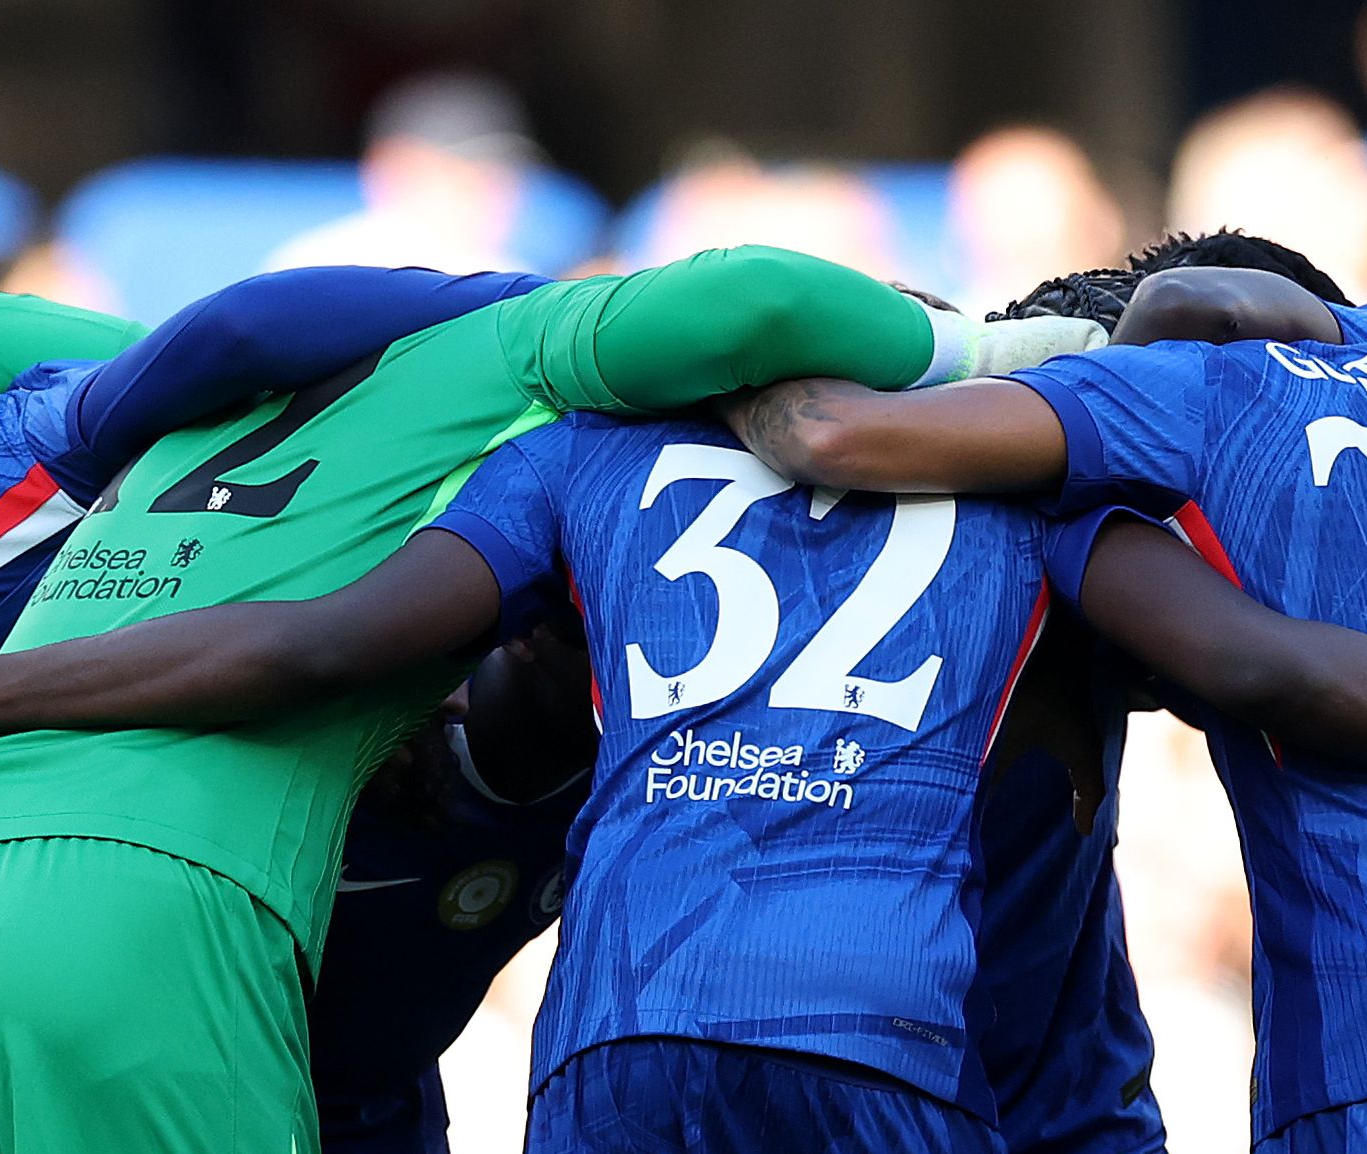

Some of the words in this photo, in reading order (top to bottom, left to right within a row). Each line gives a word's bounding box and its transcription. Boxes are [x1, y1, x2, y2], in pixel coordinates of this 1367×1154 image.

[83, 349, 385, 518] 2
[32, 571, 182, 606] oundation
[625, 443, 957, 732] 32
[651, 729, 804, 770] Chelsea
[646, 767, 854, 809] Foundation
